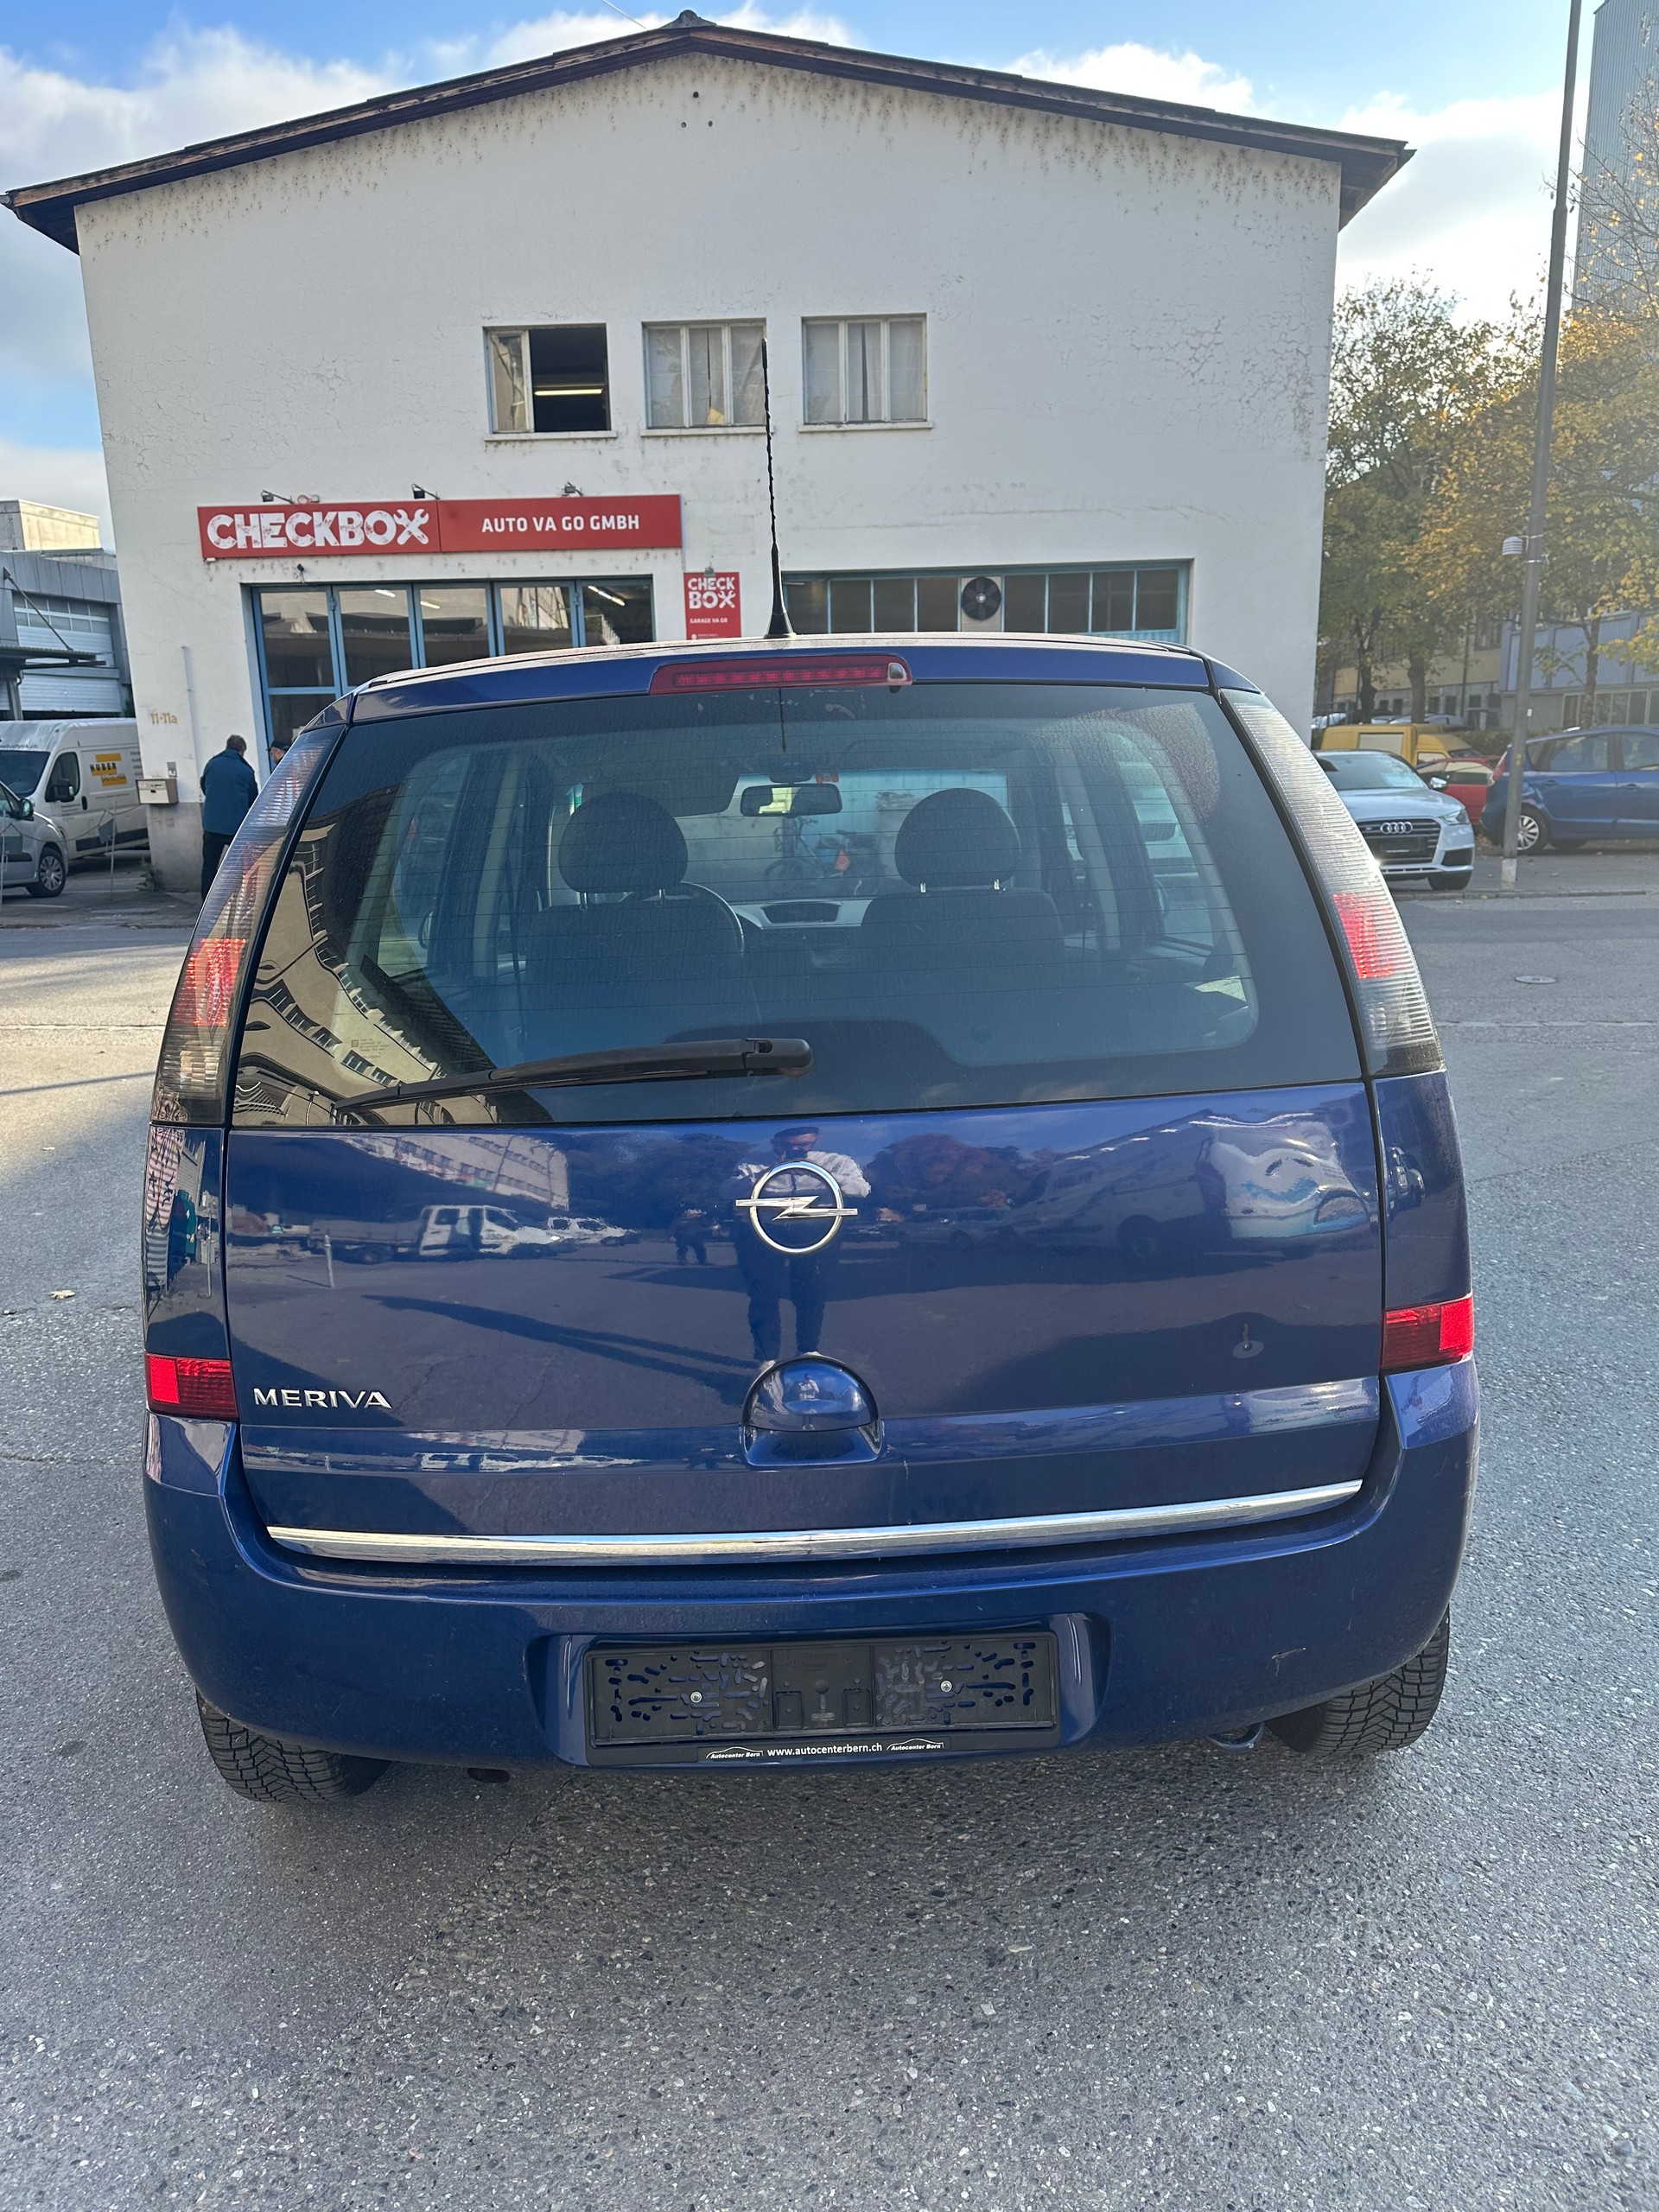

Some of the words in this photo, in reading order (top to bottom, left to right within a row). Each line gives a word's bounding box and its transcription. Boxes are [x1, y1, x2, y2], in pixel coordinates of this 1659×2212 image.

[207, 509, 429, 550] CHECKBOX
[481, 518, 528, 532] AUTO
[532, 517, 557, 531] VA
[562, 516, 585, 531] GO
[590, 515, 639, 530] GMBH
[688, 576, 735, 590] CHECK
[689, 590, 736, 609] BOX
[90, 762, 118, 772] HUBER
[253, 1388, 392, 1409] MERIVA
[766, 1742, 883, 1757] www.autocenterbern.ch
